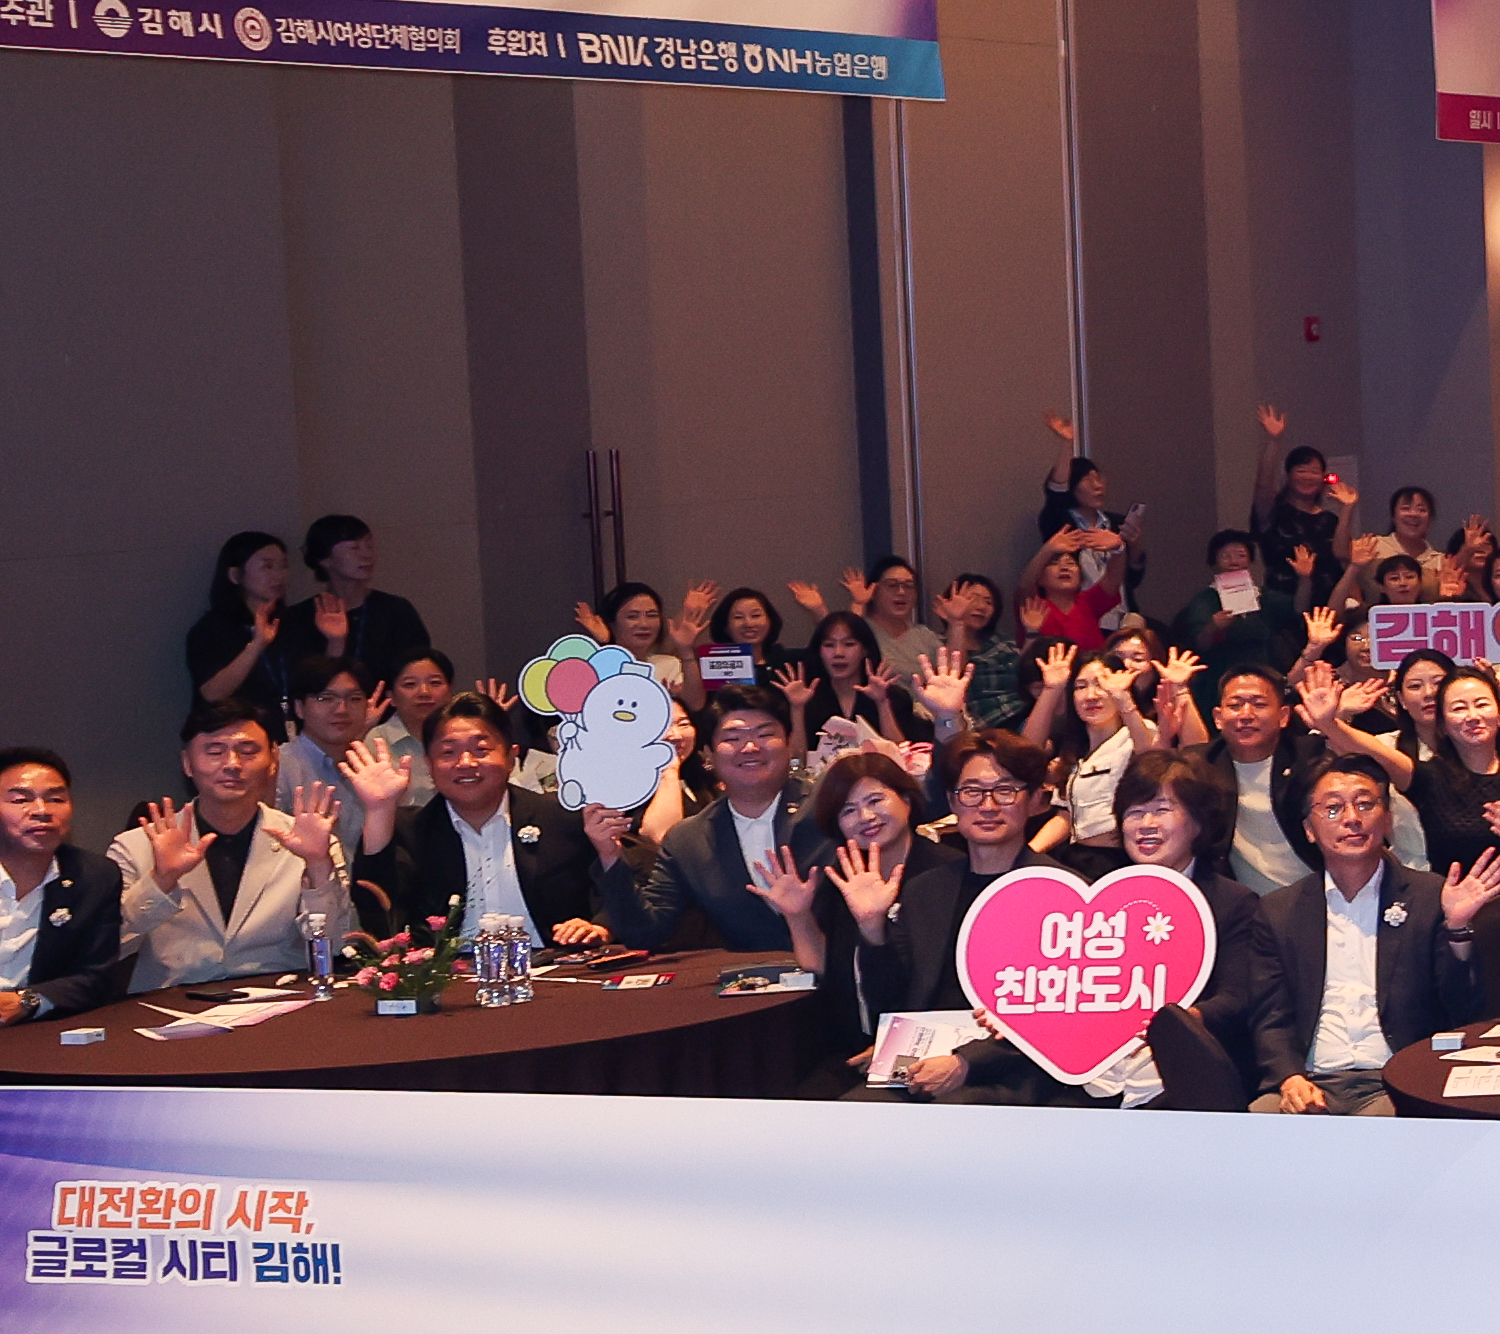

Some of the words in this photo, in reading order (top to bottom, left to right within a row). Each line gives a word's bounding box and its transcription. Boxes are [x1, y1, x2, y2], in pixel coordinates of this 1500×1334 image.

[137, 7, 225, 39] 김해시
[275, 18, 461, 54] 김해시여성단체협의회
[487, 27, 548, 58] 후원처
[577, 33, 652, 67] BNK
[654, 37, 738, 72] 경남은행
[1375, 607, 1487, 665] 김해
[1040, 911, 1128, 960] 여성
[994, 964, 1168, 1016] 친화도시
[57, 1186, 216, 1231] 대전환의
[227, 1190, 315, 1234] 시작,
[32, 1236, 147, 1280] 글로컬
[162, 1239, 237, 1282] 시티
[252, 1241, 342, 1285] 김해!
